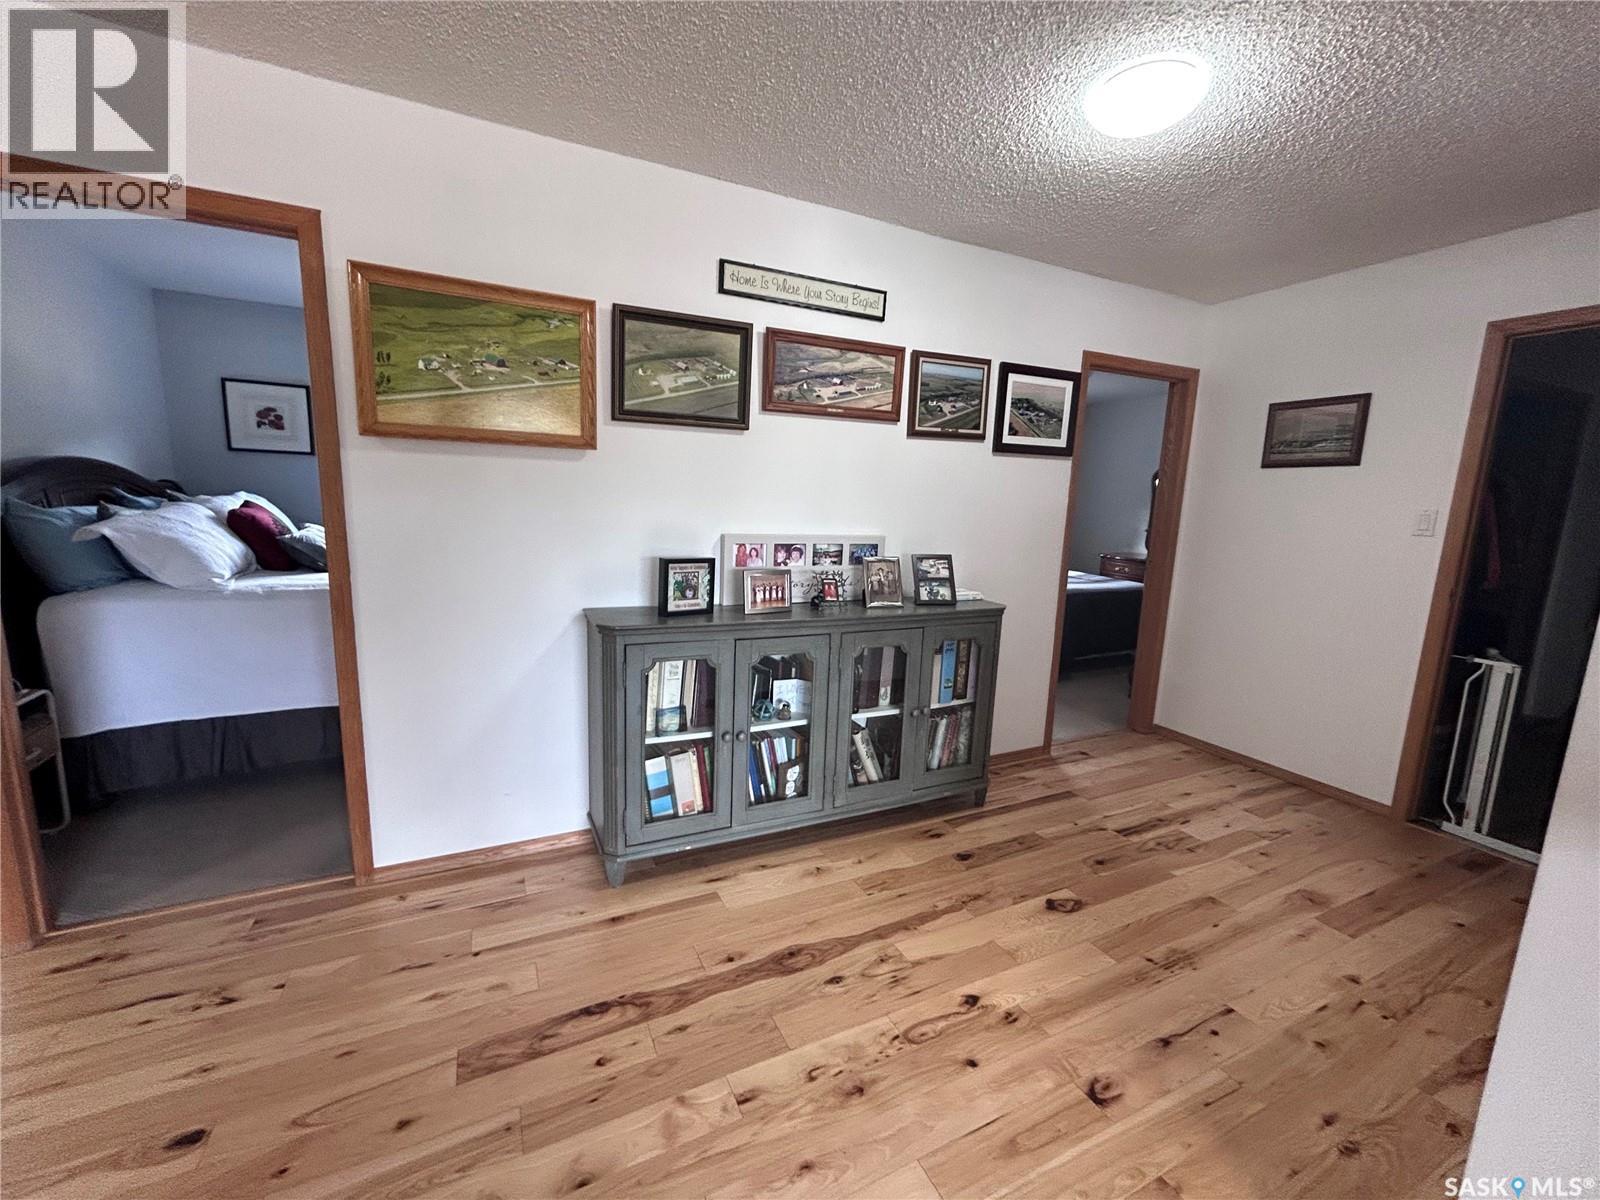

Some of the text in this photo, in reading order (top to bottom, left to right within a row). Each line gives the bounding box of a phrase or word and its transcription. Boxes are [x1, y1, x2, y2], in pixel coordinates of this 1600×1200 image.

[730, 270, 881, 311] Home Is Where Your Story Begins!
